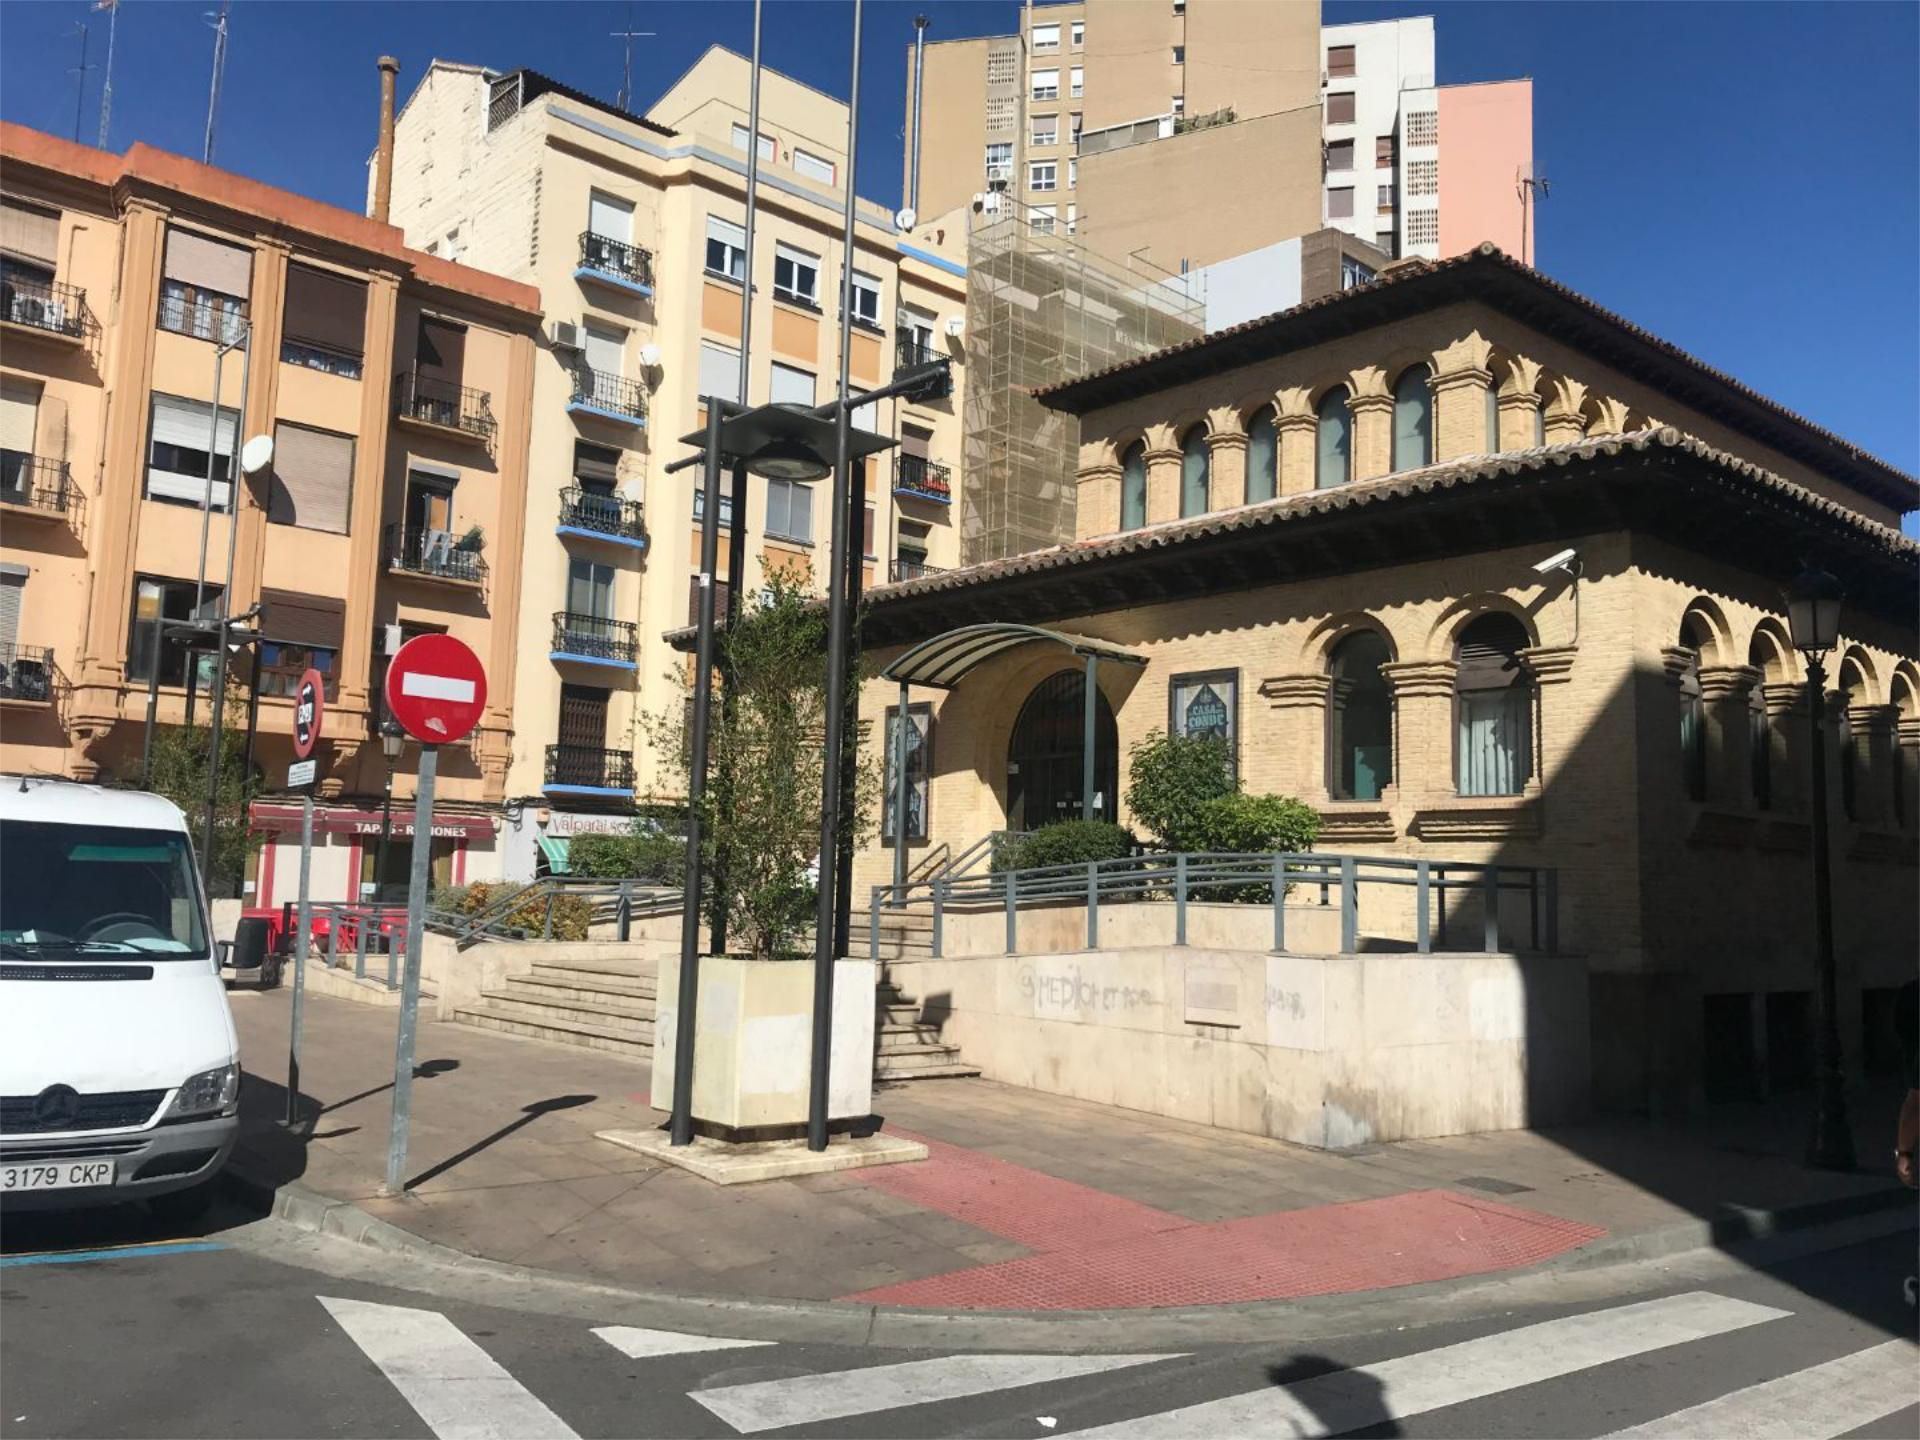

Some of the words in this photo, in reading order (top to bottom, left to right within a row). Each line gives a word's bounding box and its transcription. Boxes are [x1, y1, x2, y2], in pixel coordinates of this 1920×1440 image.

[355, 823, 396, 835] TAPS
[406, 825, 467, 838] RIONES
[4, 1167, 58, 1188] 3179
[69, 1164, 109, 1184] CKP
